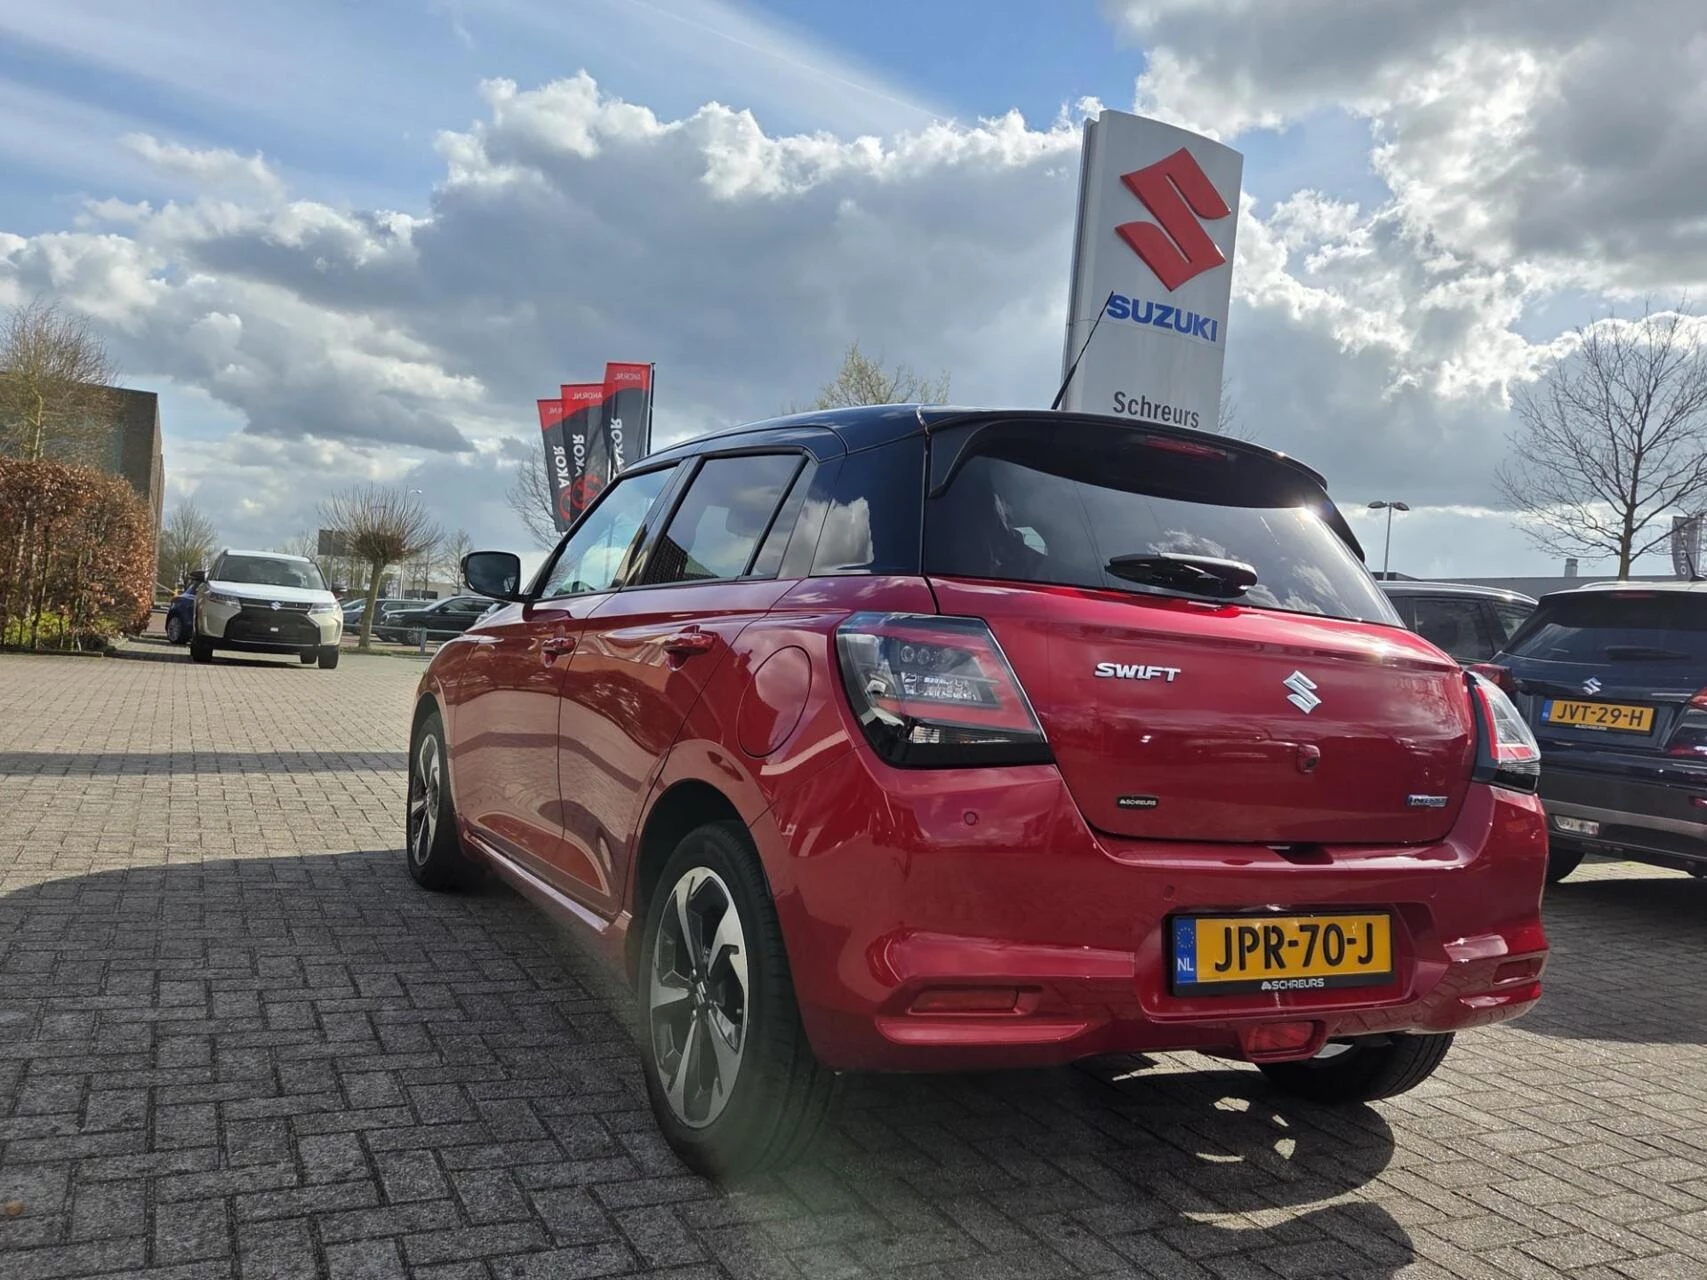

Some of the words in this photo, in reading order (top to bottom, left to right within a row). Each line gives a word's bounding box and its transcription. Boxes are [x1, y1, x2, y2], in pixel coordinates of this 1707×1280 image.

[1106, 294, 1218, 342] SUZUKI
[1113, 391, 1199, 429] Schreurs
[1095, 662, 1181, 683] SWIFT
[1557, 703, 1644, 727] JVT-29-H
[1214, 922, 1374, 973] JPR-70-J
[1177, 957, 1194, 972] NL
[1271, 977, 1325, 990] SCHREURS
